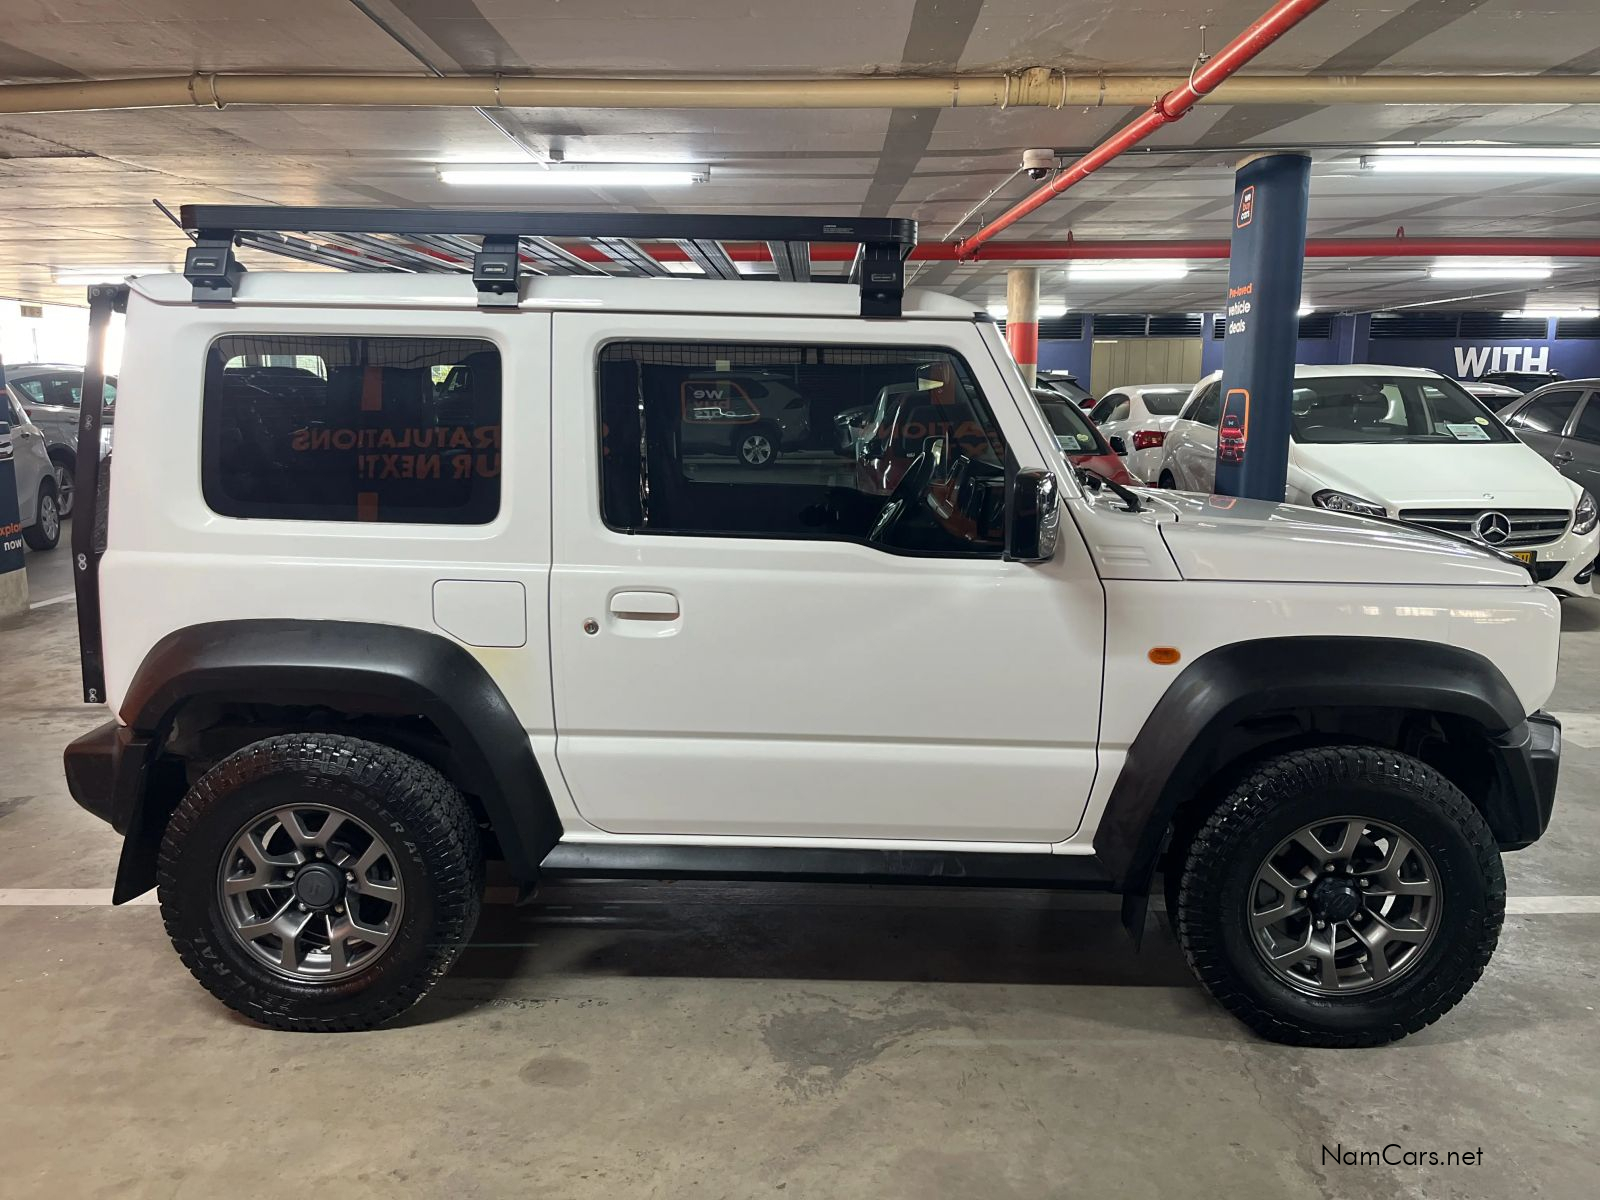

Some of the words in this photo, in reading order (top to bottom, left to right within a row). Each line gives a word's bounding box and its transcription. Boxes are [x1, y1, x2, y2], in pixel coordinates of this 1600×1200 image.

[1228, 299, 1251, 317] vehicle
[1228, 318, 1246, 335] deals
[1453, 346, 1550, 378] WITH
[4, 539, 22, 551] now
